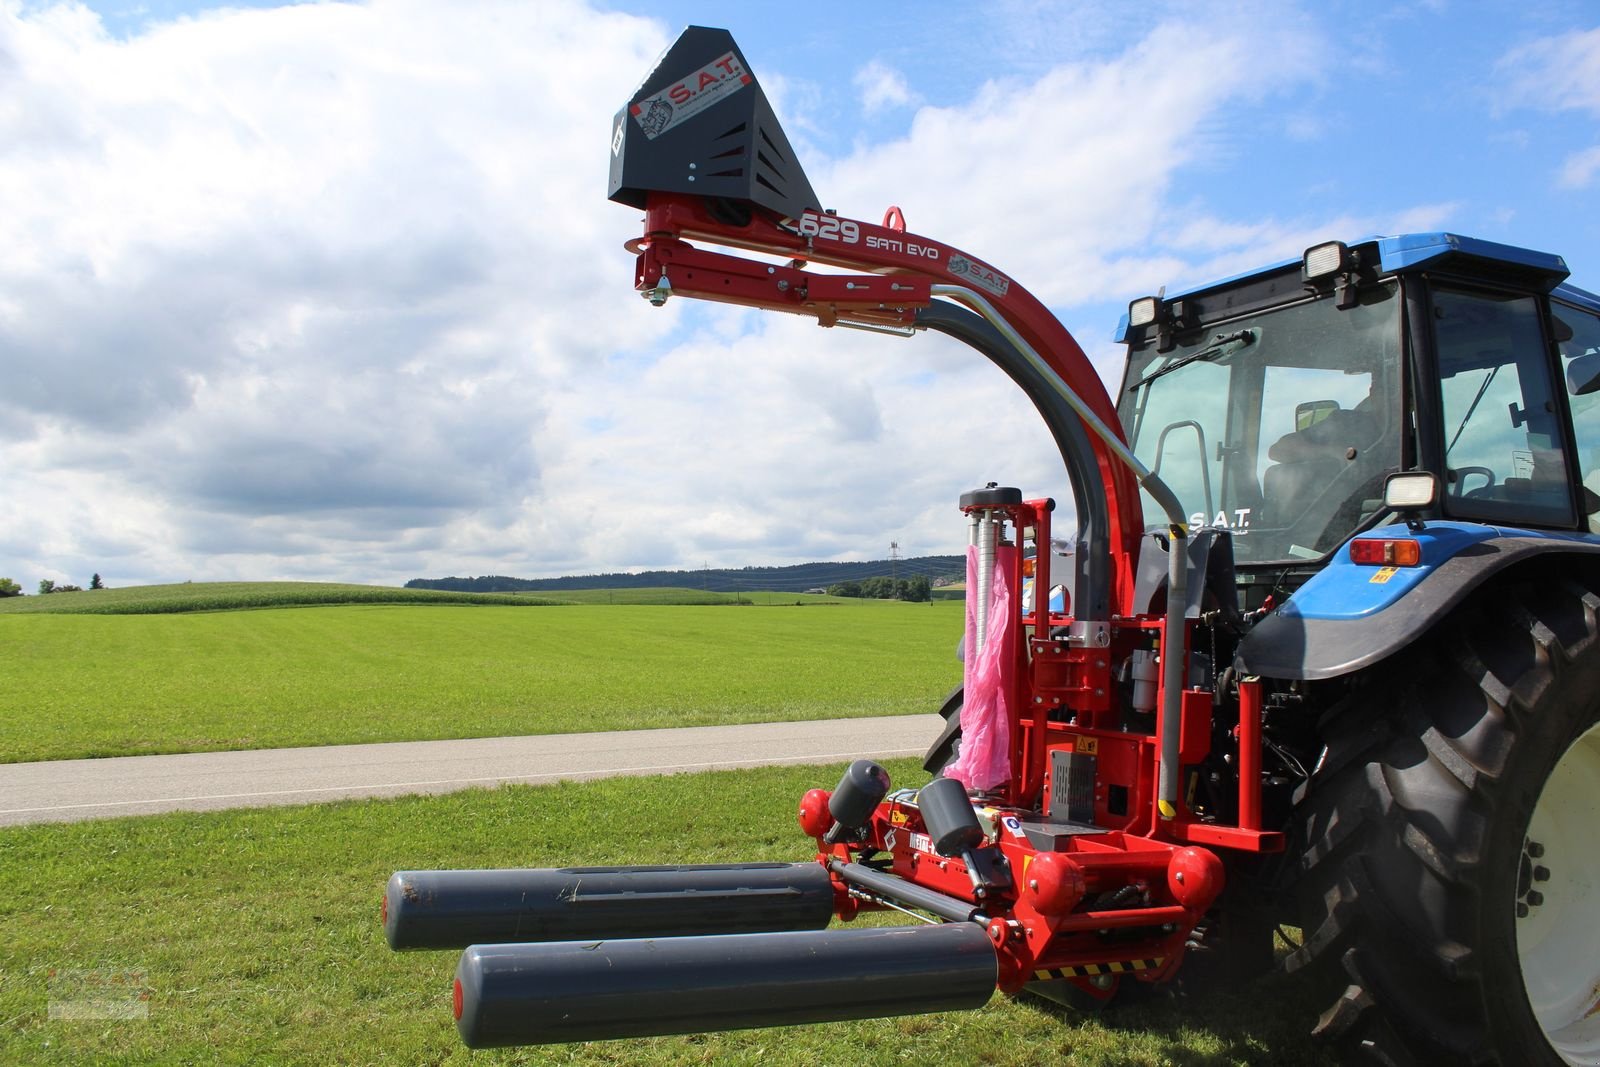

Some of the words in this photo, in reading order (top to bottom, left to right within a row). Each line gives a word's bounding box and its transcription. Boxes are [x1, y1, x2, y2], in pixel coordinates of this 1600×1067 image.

[668, 55, 740, 105] S.A.T.
[865, 235, 903, 253] SATI
[906, 242, 939, 260] EVO
[1188, 507, 1251, 531] S.A.T.
